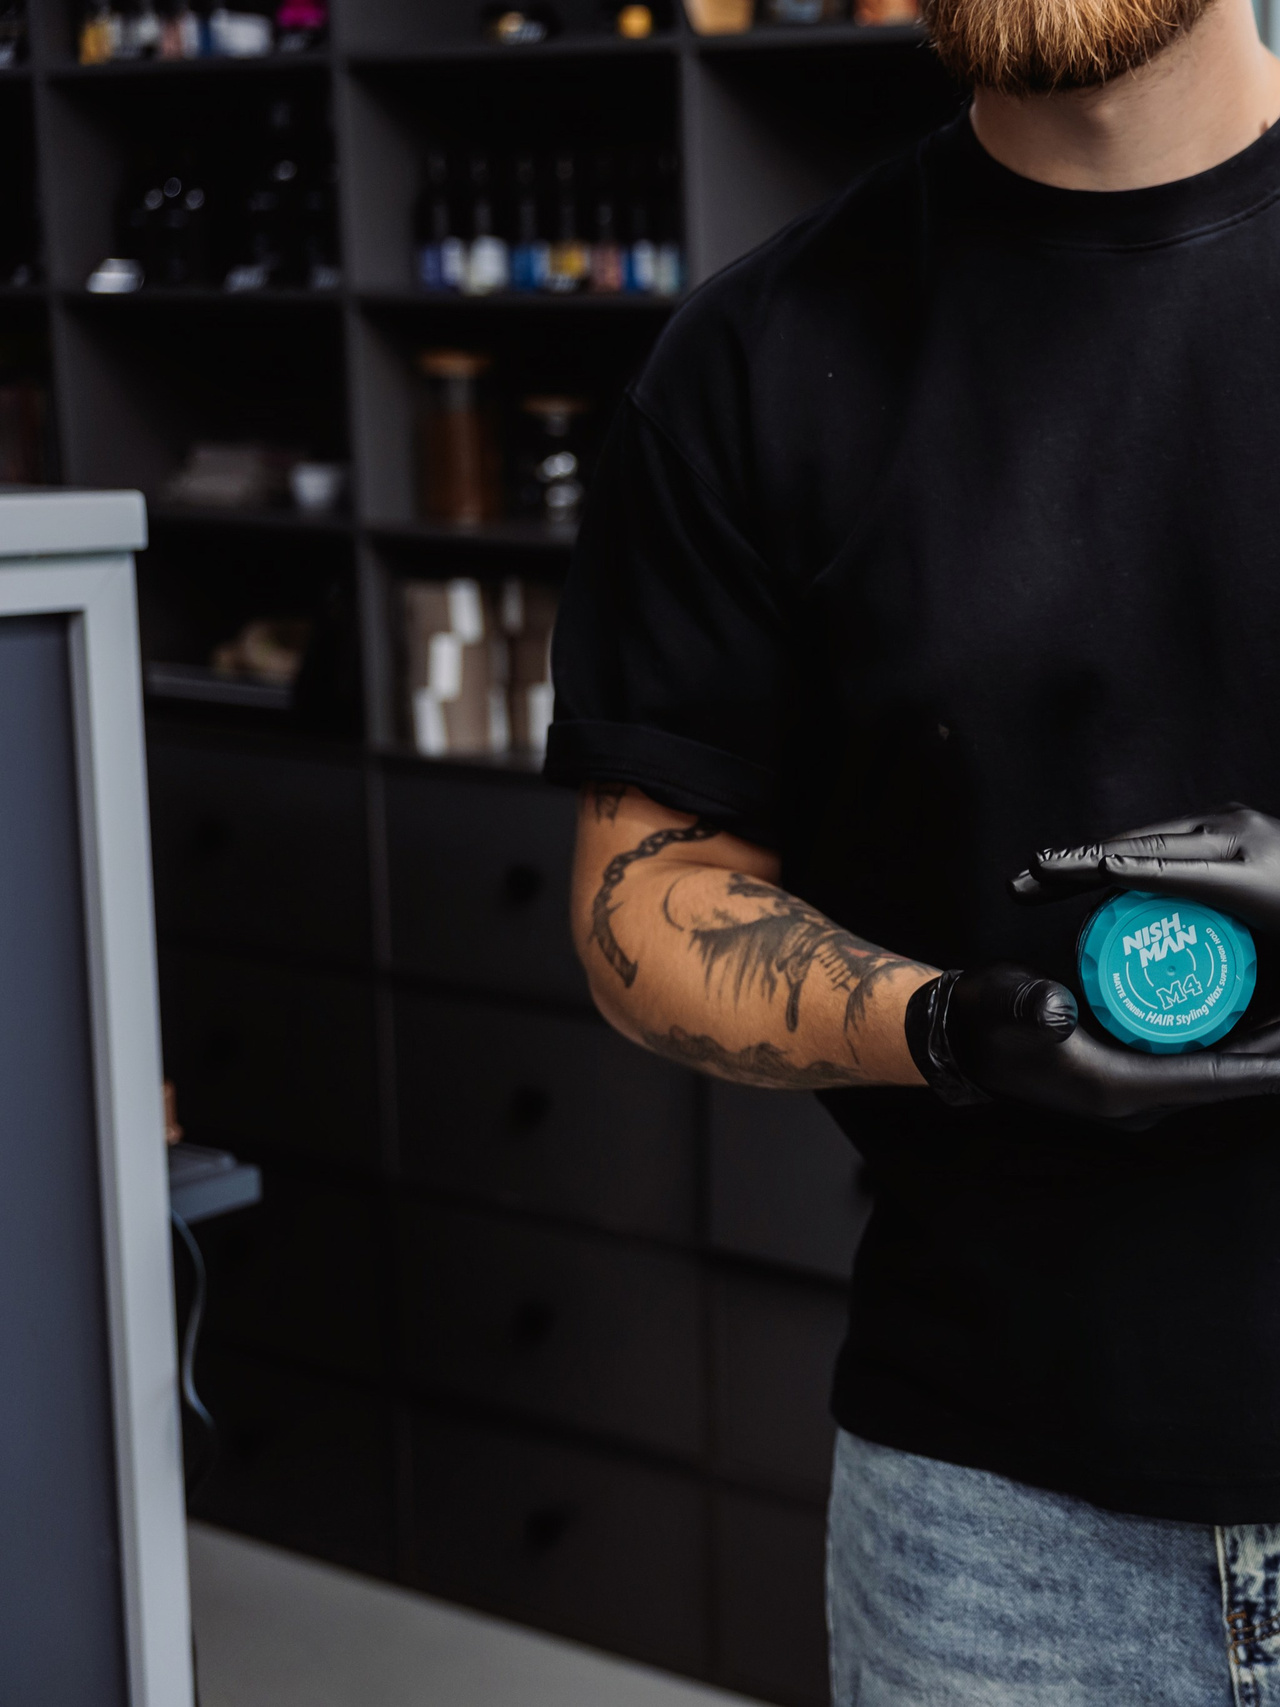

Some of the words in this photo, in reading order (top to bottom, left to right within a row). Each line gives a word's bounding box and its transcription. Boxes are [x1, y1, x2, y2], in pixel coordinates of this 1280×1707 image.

[1122, 912, 1181, 956] NISH
[1206, 928, 1221, 944] HOLD
[1139, 924, 1198, 968] MAN
[1217, 945, 1227, 962] HIGH
[1113, 973, 1126, 999] MATTE
[1219, 964, 1228, 986] SUPER
[1156, 973, 1203, 1010] M4
[1204, 985, 1224, 1007] Wax
[1122, 997, 1146, 1020] FINISH
[1145, 1010, 1175, 1027] HAIR
[1175, 1004, 1210, 1026] Styling
